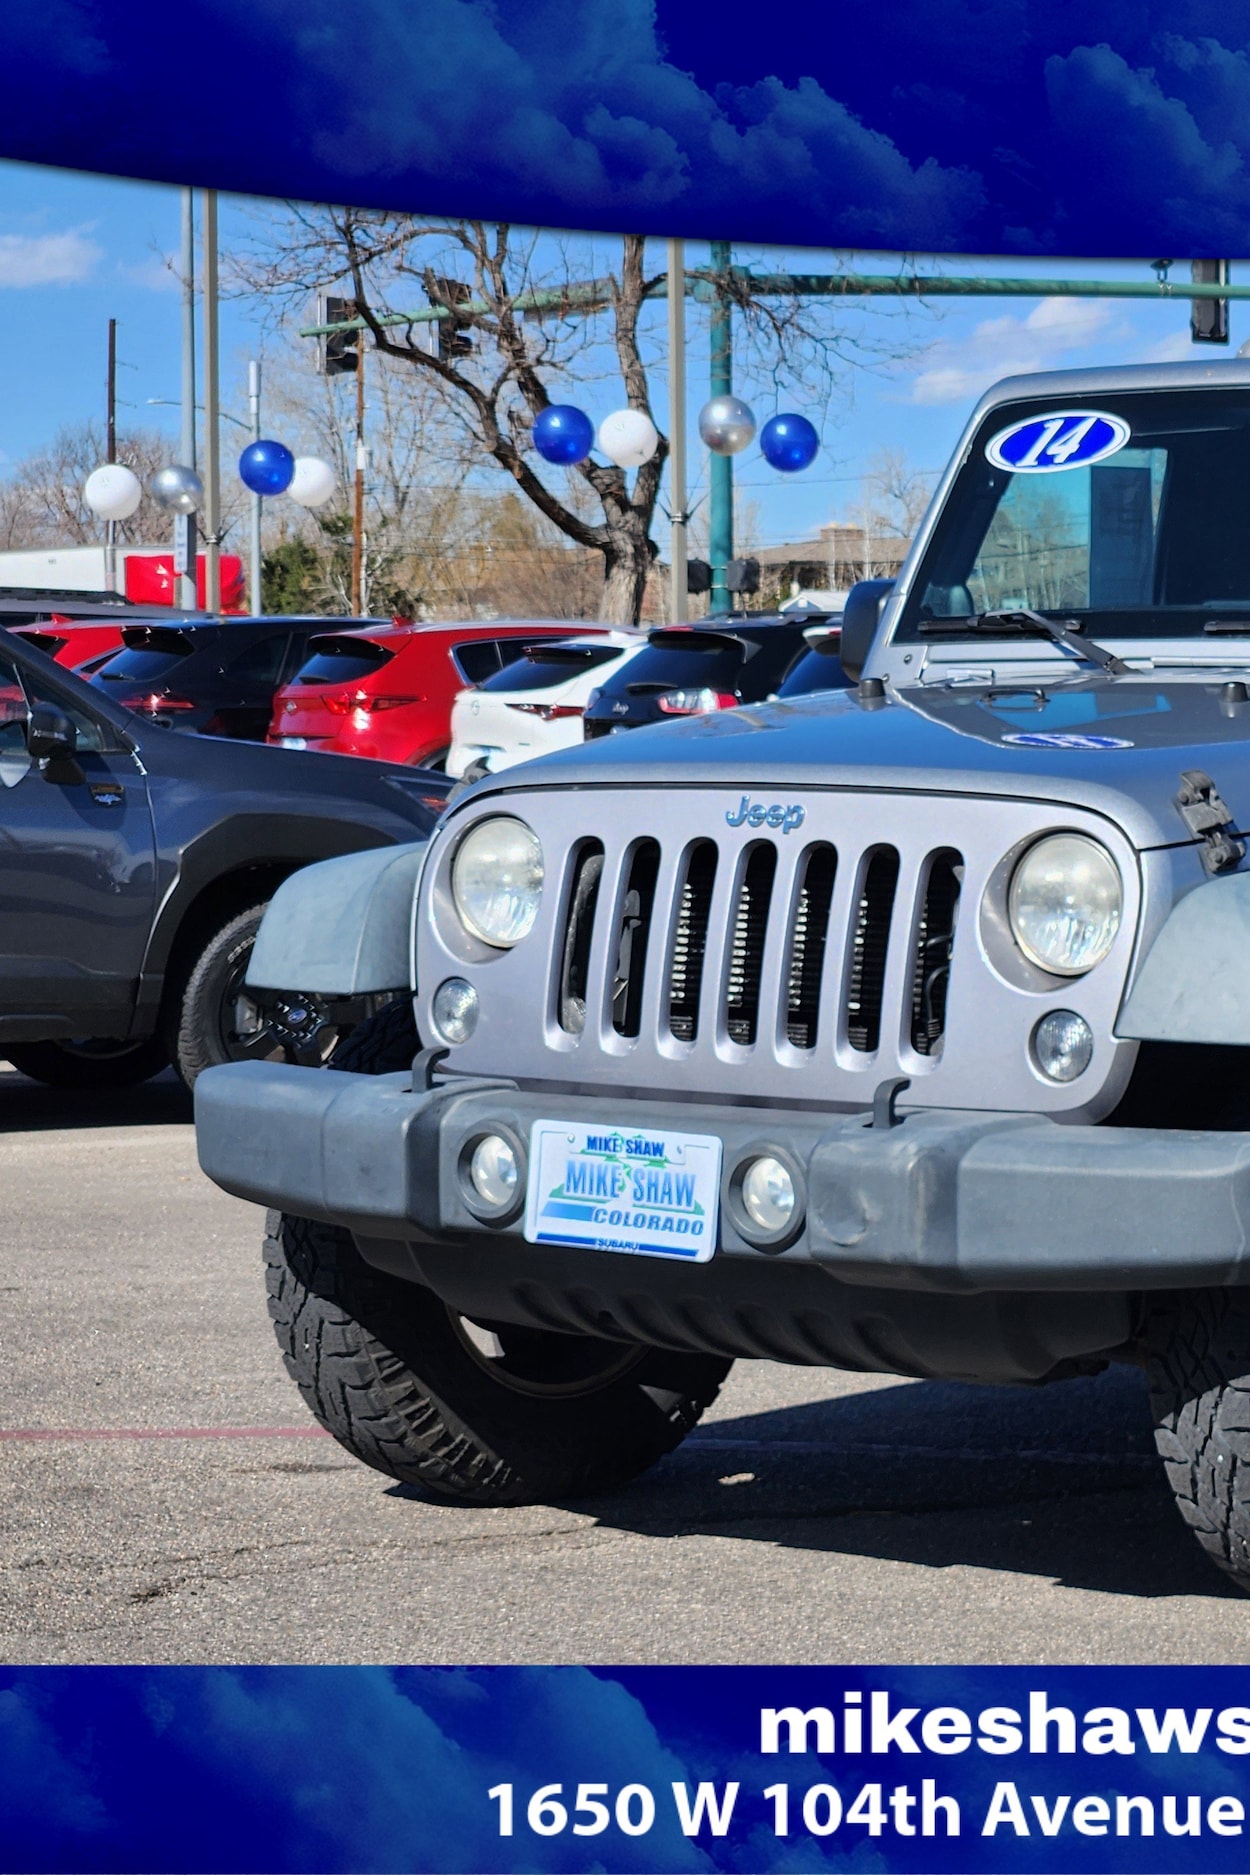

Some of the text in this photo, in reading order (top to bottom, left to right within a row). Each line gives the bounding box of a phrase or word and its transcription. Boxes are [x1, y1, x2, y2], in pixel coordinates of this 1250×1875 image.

[1015, 416, 1098, 467] 14
[725, 794, 806, 835] Jeep
[587, 1135, 665, 1157] MIKE SHAW
[566, 1160, 696, 1208] MIKE SHAW
[593, 1207, 704, 1236] COLORADO
[598, 1236, 639, 1251] SUBARU
